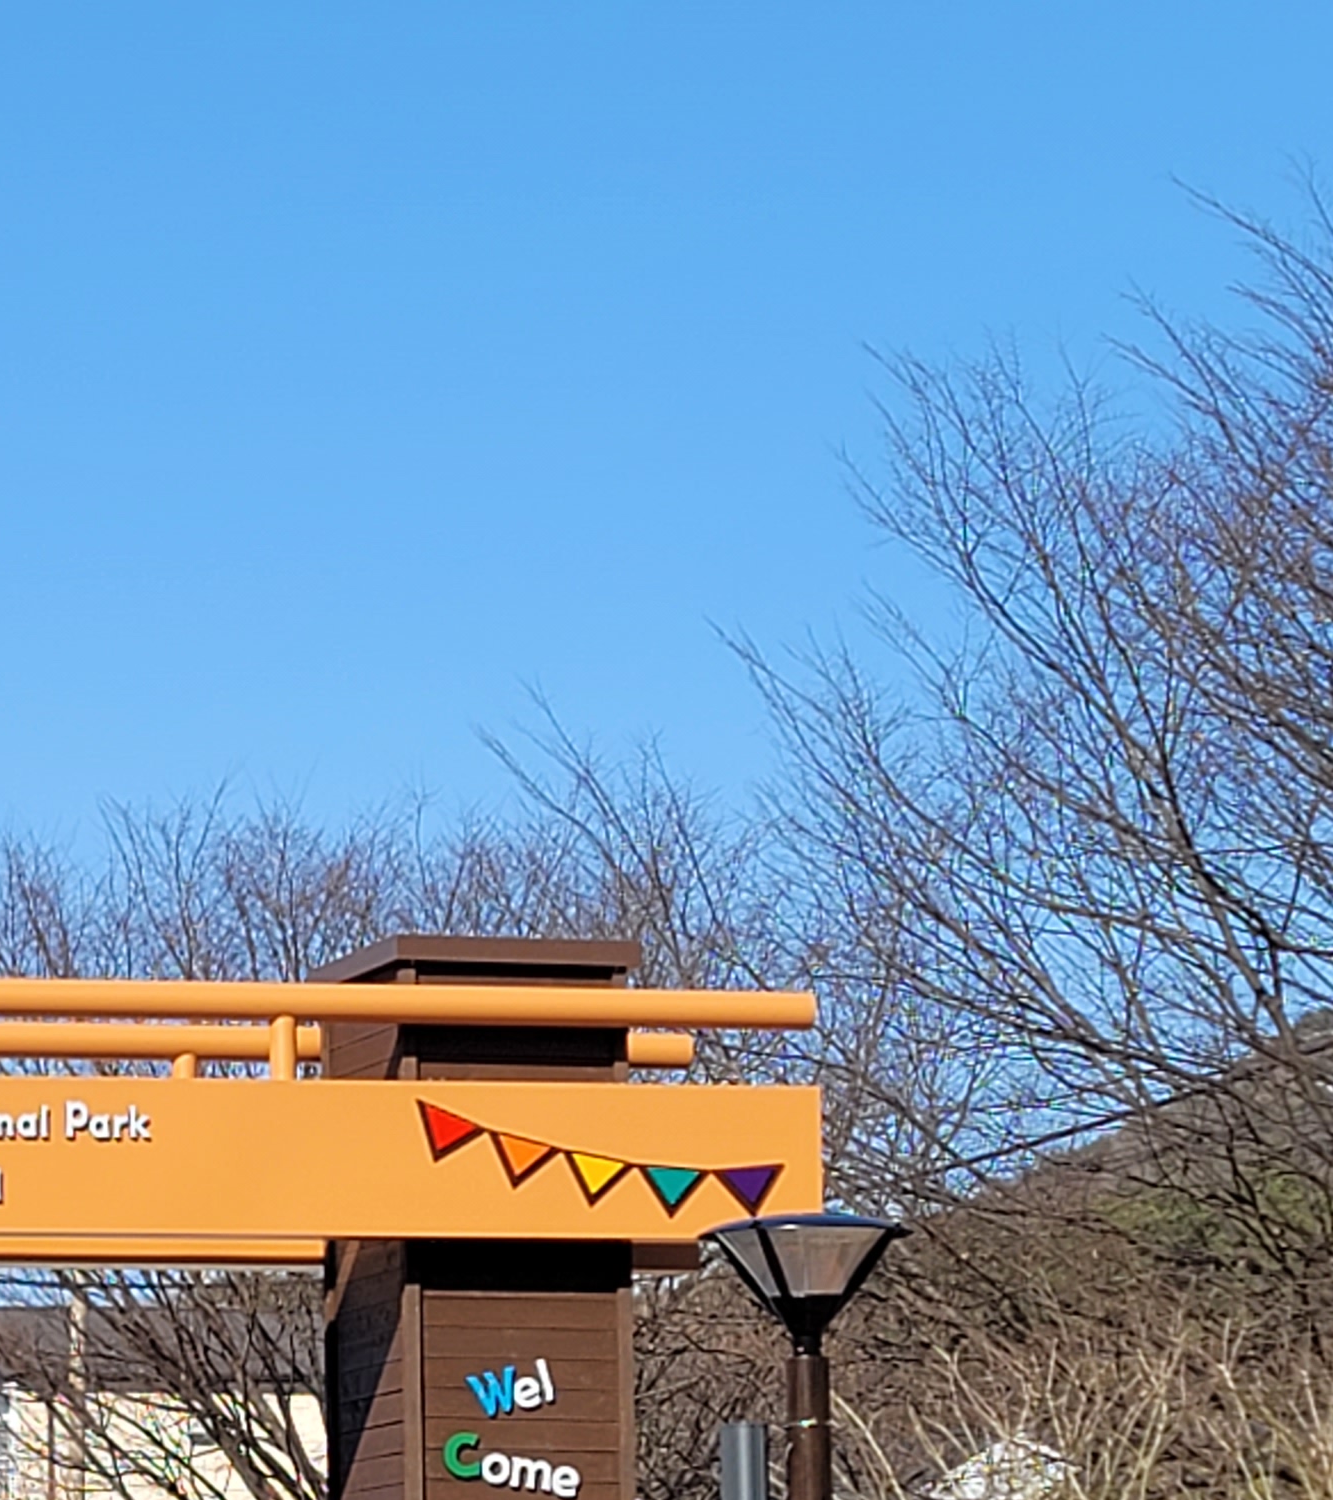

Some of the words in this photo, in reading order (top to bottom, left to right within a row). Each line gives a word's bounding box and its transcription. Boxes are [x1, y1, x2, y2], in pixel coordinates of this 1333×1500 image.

[64, 1100, 152, 1141] Park
[465, 1358, 555, 1418] Wel
[443, 1432, 581, 1499] Come
